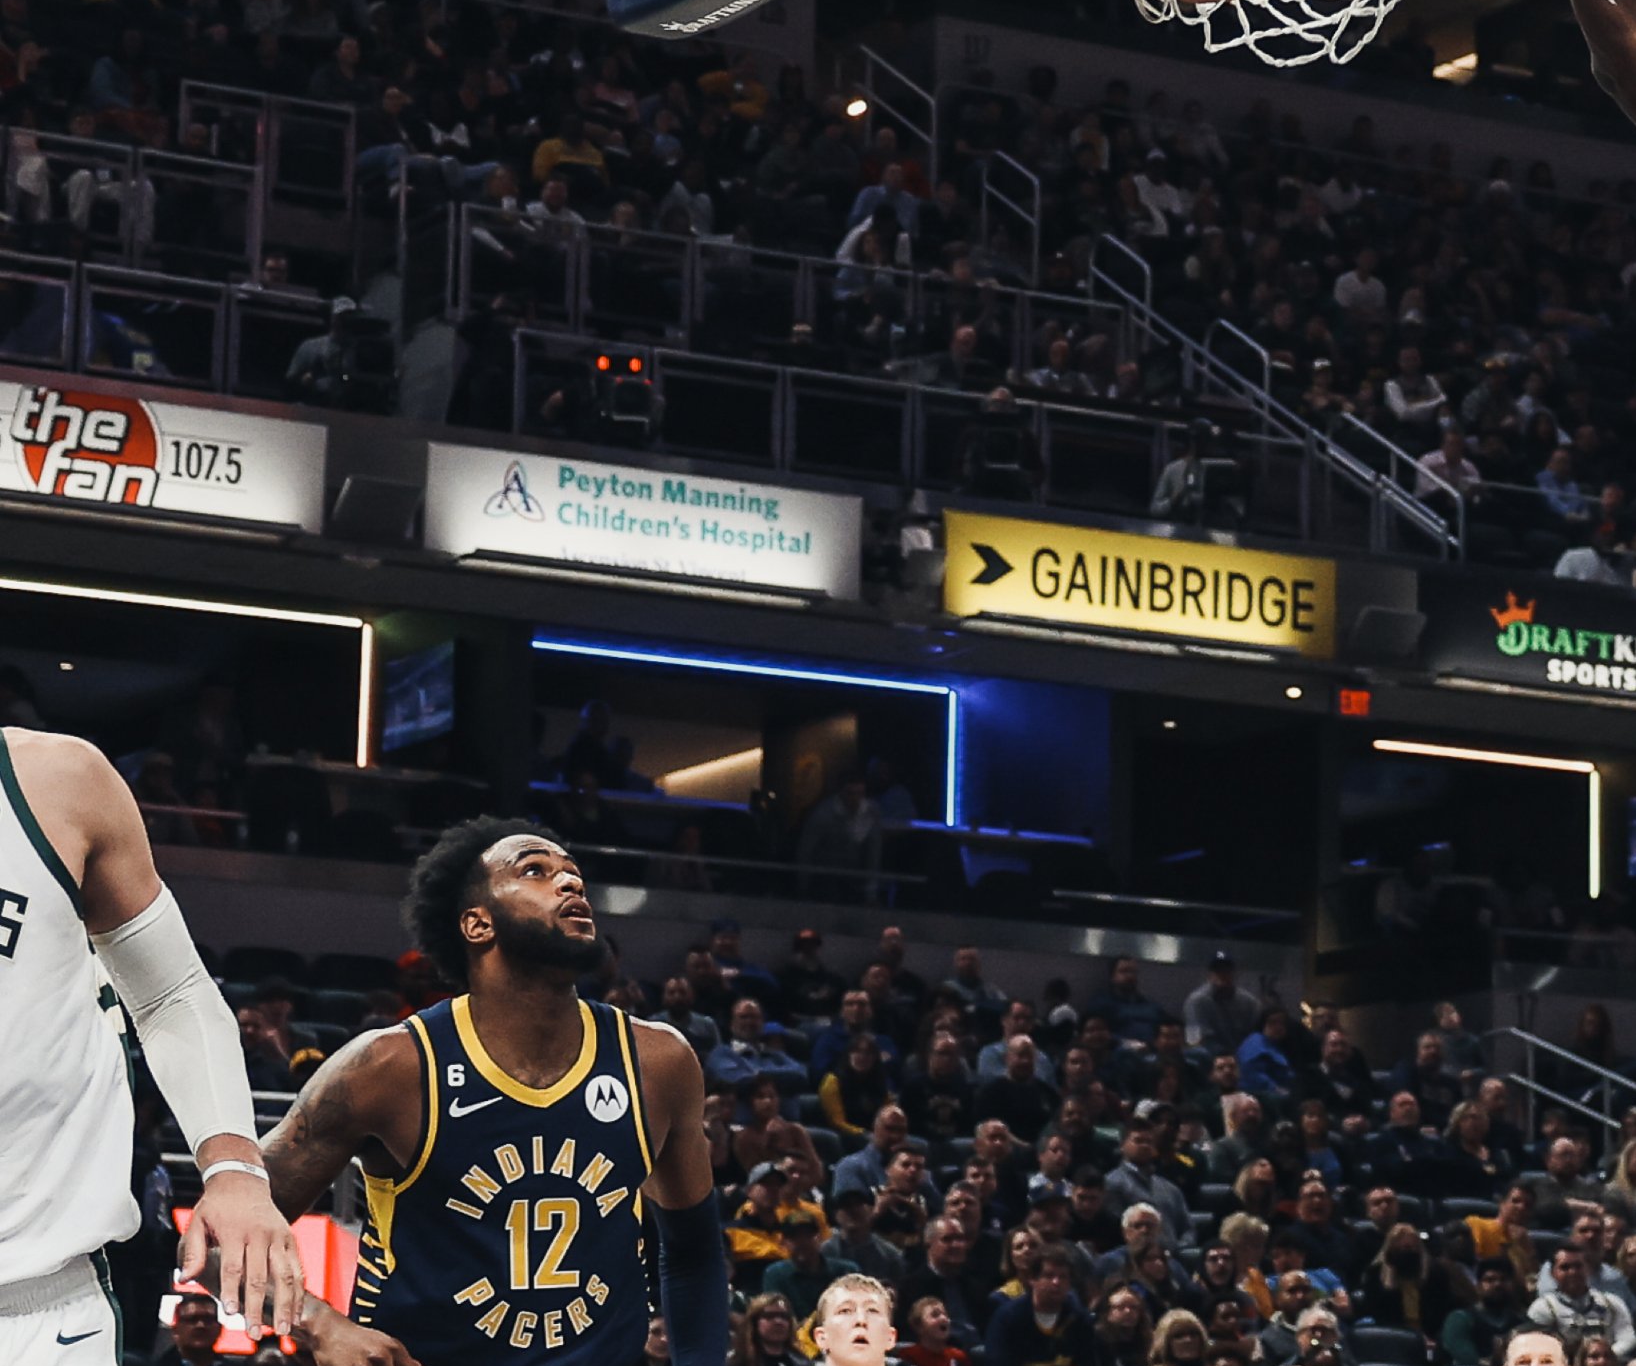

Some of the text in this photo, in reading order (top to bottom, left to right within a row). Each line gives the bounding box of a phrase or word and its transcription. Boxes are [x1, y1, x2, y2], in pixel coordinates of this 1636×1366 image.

[10, 387, 128, 452] the
[36, 438, 158, 508] fan
[171, 438, 242, 485] 107.5
[558, 464, 781, 521] Peyton Manning
[557, 502, 812, 554] Children's Hospital
[1031, 547, 1315, 633] GAINBRIDGE
[447, 1064, 465, 1086] 6
[446, 1135, 629, 1220] INDIANA
[504, 1196, 580, 1290] 12
[453, 1274, 610, 1349] PACERS
